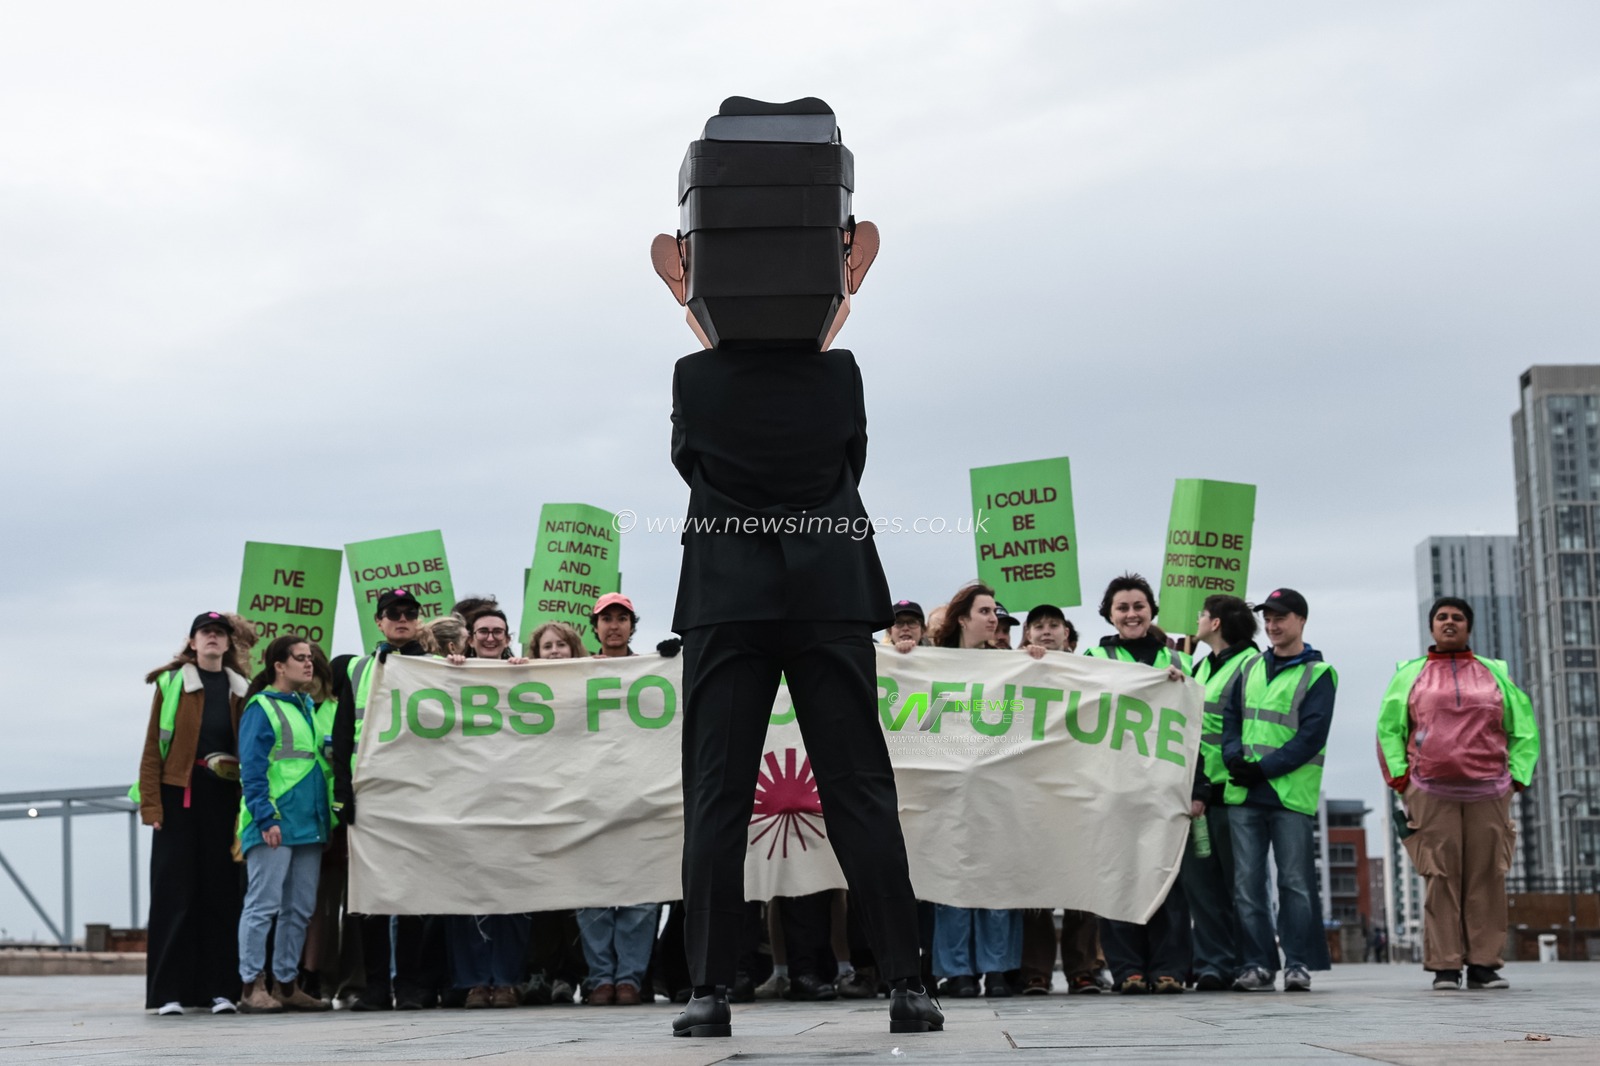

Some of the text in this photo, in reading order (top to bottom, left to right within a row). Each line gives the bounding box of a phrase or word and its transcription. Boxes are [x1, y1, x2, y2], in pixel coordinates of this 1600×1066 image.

[986, 487, 1057, 510] I COULD
[545, 520, 614, 542] NATIONAL
[1012, 514, 1035, 531] BE
[547, 540, 609, 560] CLIMATE
[980, 535, 1069, 561] PLANTING
[1168, 530, 1244, 551] I COULD BE
[354, 557, 445, 583] I COULD BE
[558, 560, 592, 576] AND
[1001, 562, 1056, 583] TREES
[1166, 553, 1241, 572] PROTECTING
[273, 569, 306, 588] I'VE
[1166, 574, 1235, 592] OUR RIVERS
[365, 580, 443, 604] FITING
[543, 579, 600, 599] NATURE
[249, 594, 324, 616] APPLIED
[538, 600, 594, 617] SERVIC
[281, 623, 324, 643] 300
[378, 681, 556, 743] JOBS
[586, 675, 678, 732] FO
[928, 680, 1188, 767] FUTURE
